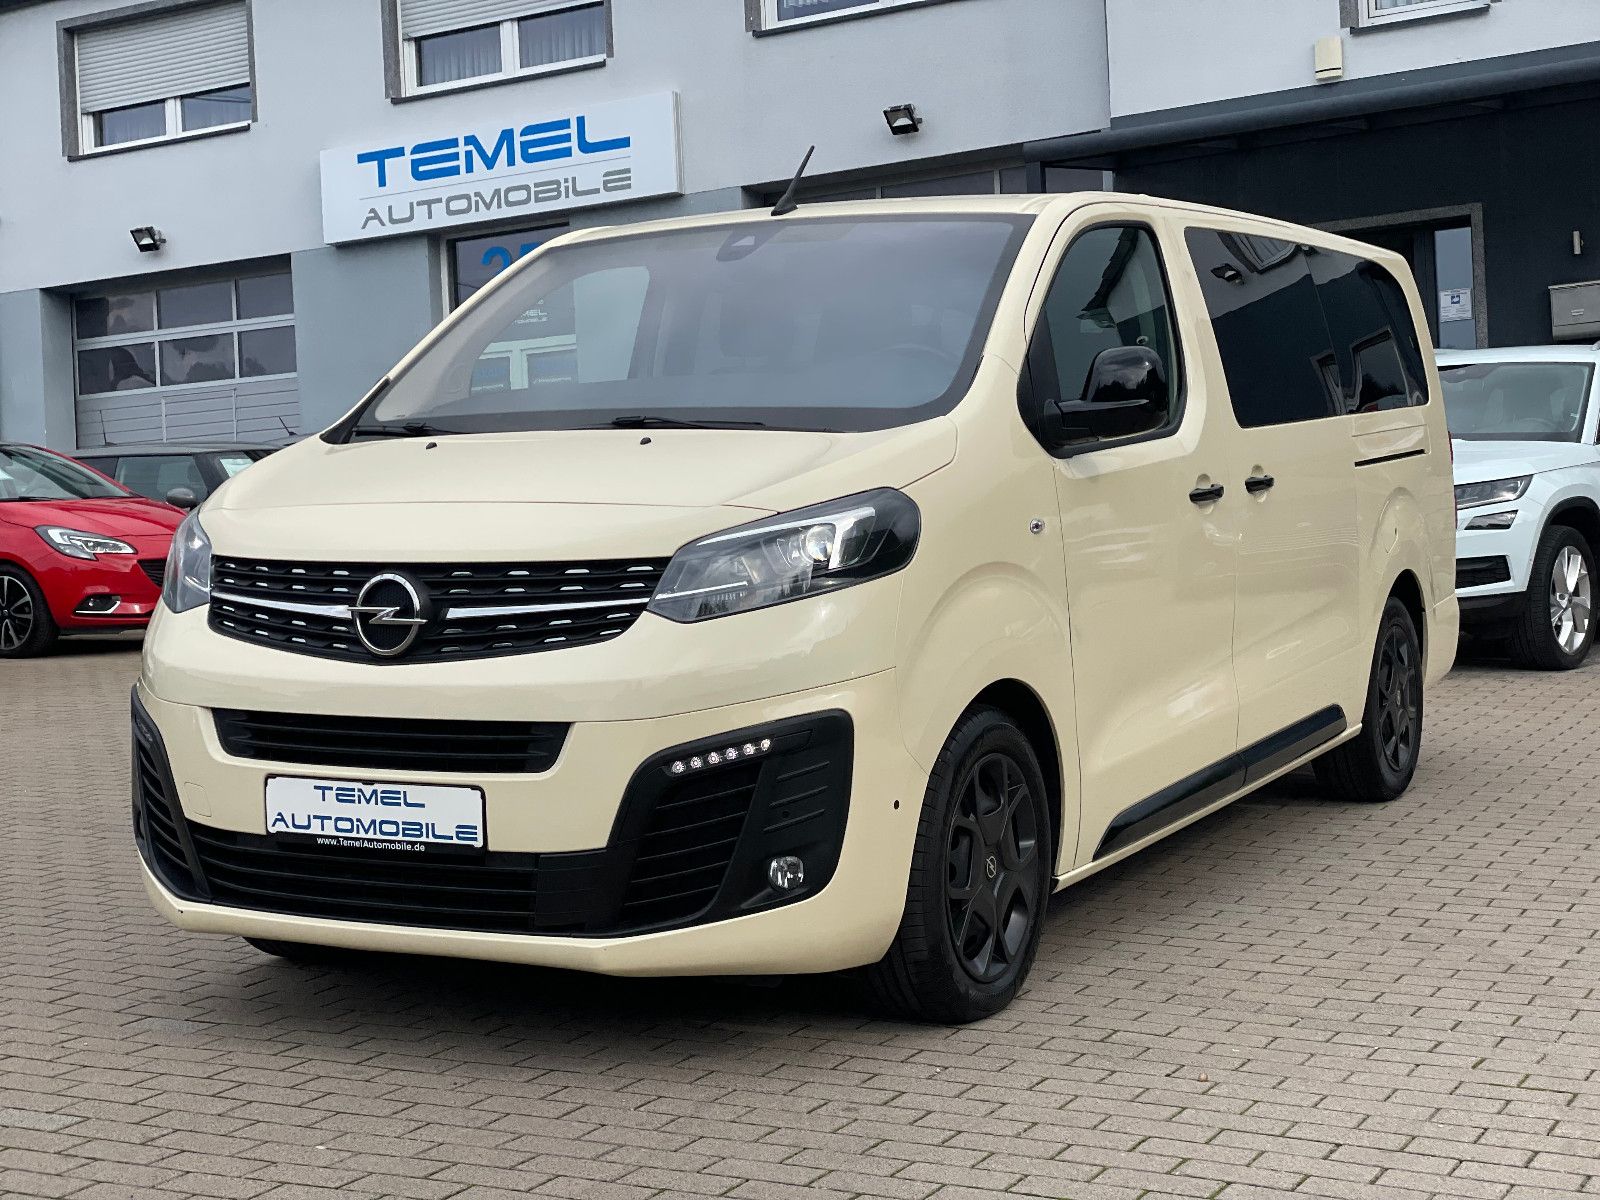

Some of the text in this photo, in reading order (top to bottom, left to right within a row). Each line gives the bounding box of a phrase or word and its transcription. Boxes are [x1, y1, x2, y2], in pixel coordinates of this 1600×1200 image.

[357, 115, 631, 188] TEMEL
[313, 785, 426, 809] TEMEL
[271, 811, 479, 842] AUTOMOBILE
[316, 837, 426, 852] www.TemelAutomobile.de
